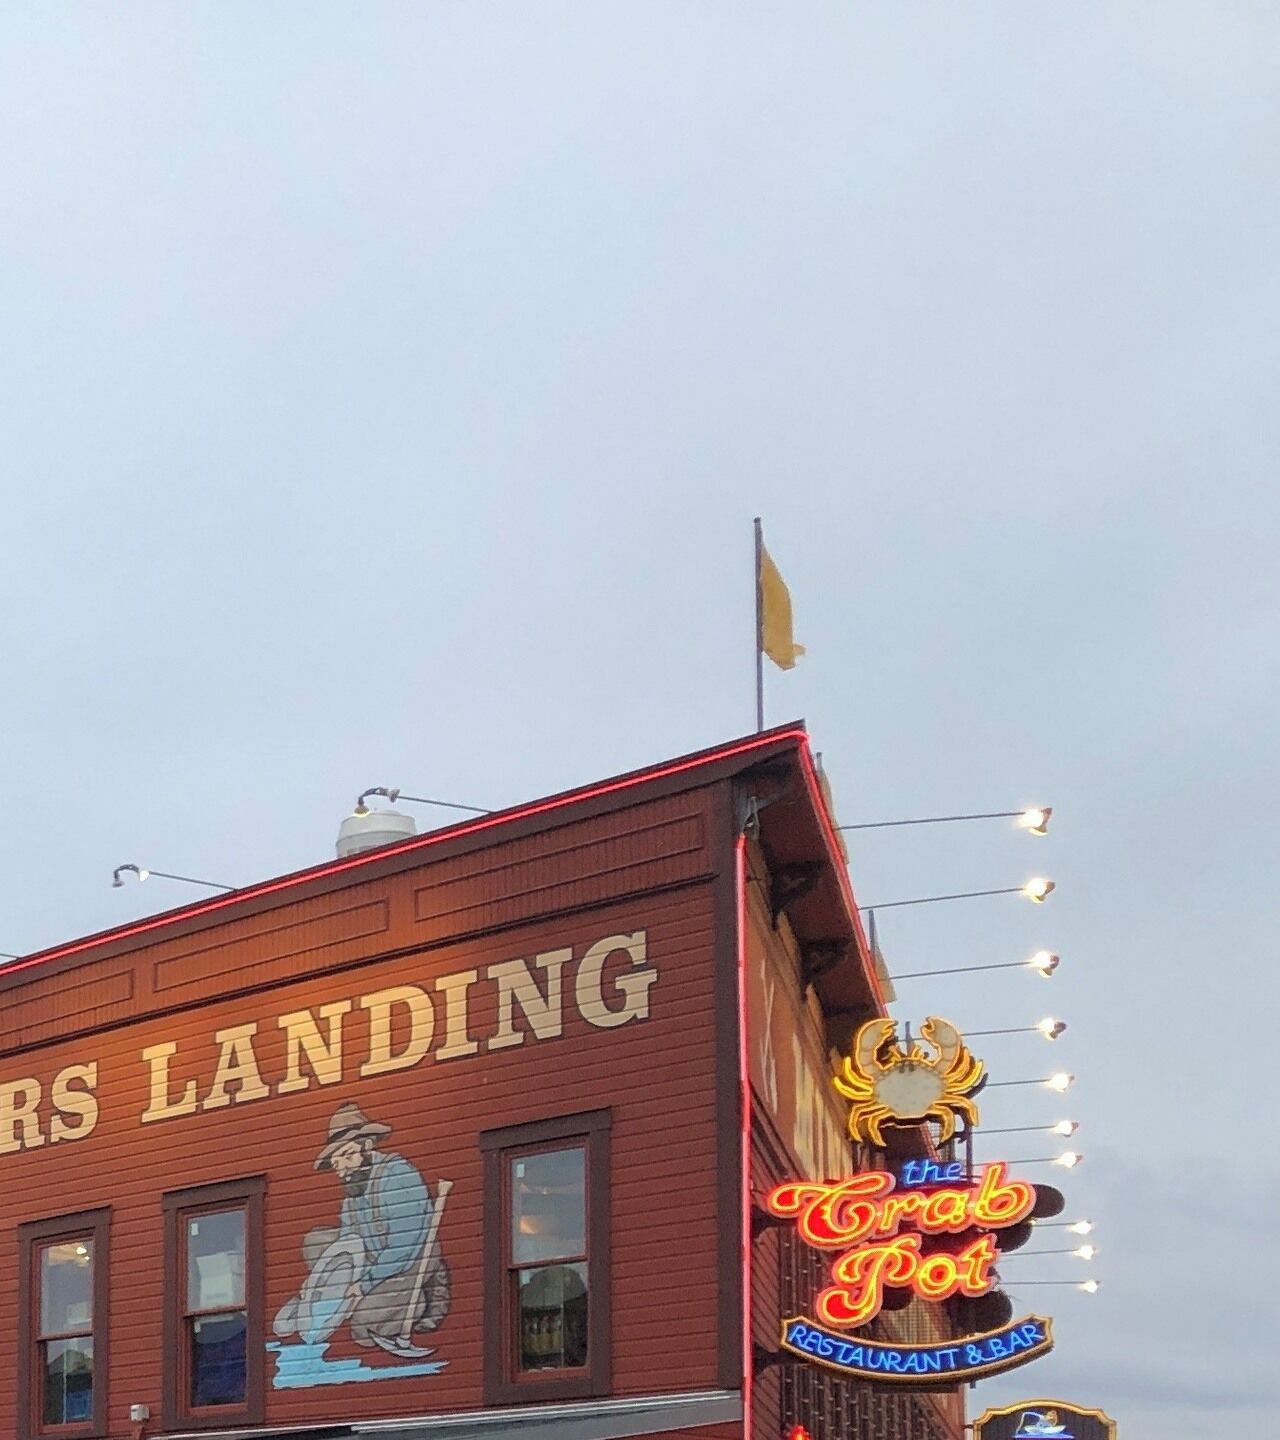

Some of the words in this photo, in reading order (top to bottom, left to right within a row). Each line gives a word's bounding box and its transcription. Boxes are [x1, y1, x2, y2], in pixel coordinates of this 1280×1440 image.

[141, 930, 658, 1123] LANDING
[767, 1161, 1037, 1251] Crab
[903, 1159, 963, 1185] the
[817, 1233, 1000, 1328] Pot
[790, 1325, 962, 1372] RESTAURANT
[968, 1343, 985, 1364] &
[987, 1323, 1044, 1359] BAR
